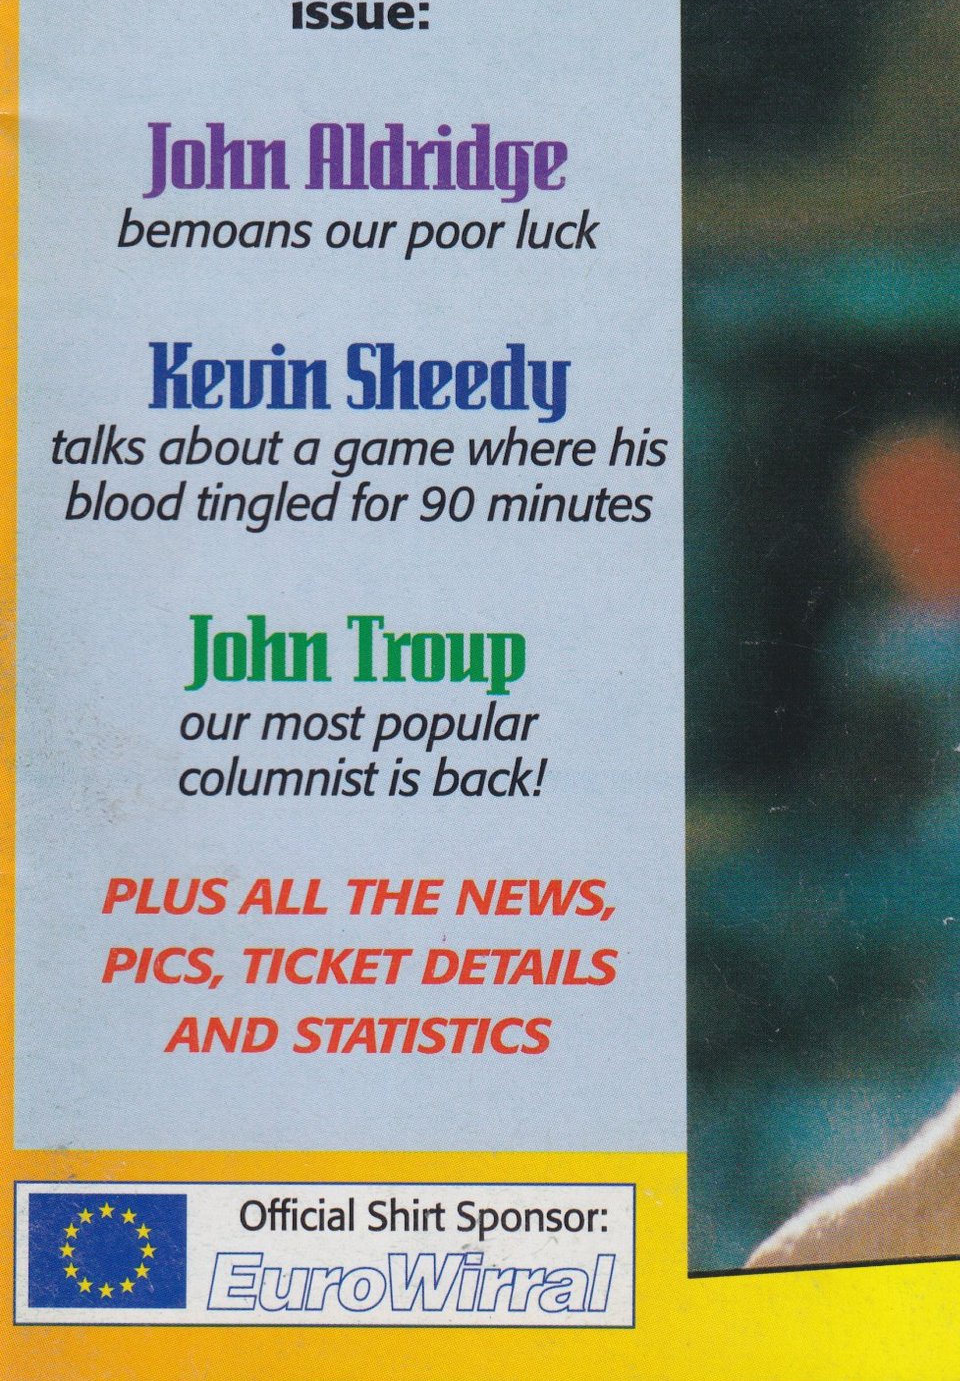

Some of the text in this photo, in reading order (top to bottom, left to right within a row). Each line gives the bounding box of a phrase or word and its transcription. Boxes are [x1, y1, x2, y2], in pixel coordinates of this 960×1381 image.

[143, 122, 567, 203] John Aldridge
[118, 207, 599, 260] bemoans our poor luck
[149, 342, 571, 423] Kevin Sheedy
[52, 424, 668, 478] talks about a game where his
[65, 480, 653, 533] blood tingled for 90 minutes
[185, 615, 525, 695] John Troup
[180, 701, 539, 752] our most popular
[179, 756, 547, 797] columnist is back!
[102, 878, 615, 921] PLUS ALL THE NEWS,
[102, 947, 618, 989] PICS, TICKET DETAILS
[164, 1017, 552, 1054] AND STATISTICS
[240, 1198, 607, 1241] Official Shirt Sponsor:
[207, 1252, 617, 1312] EuroWirral
